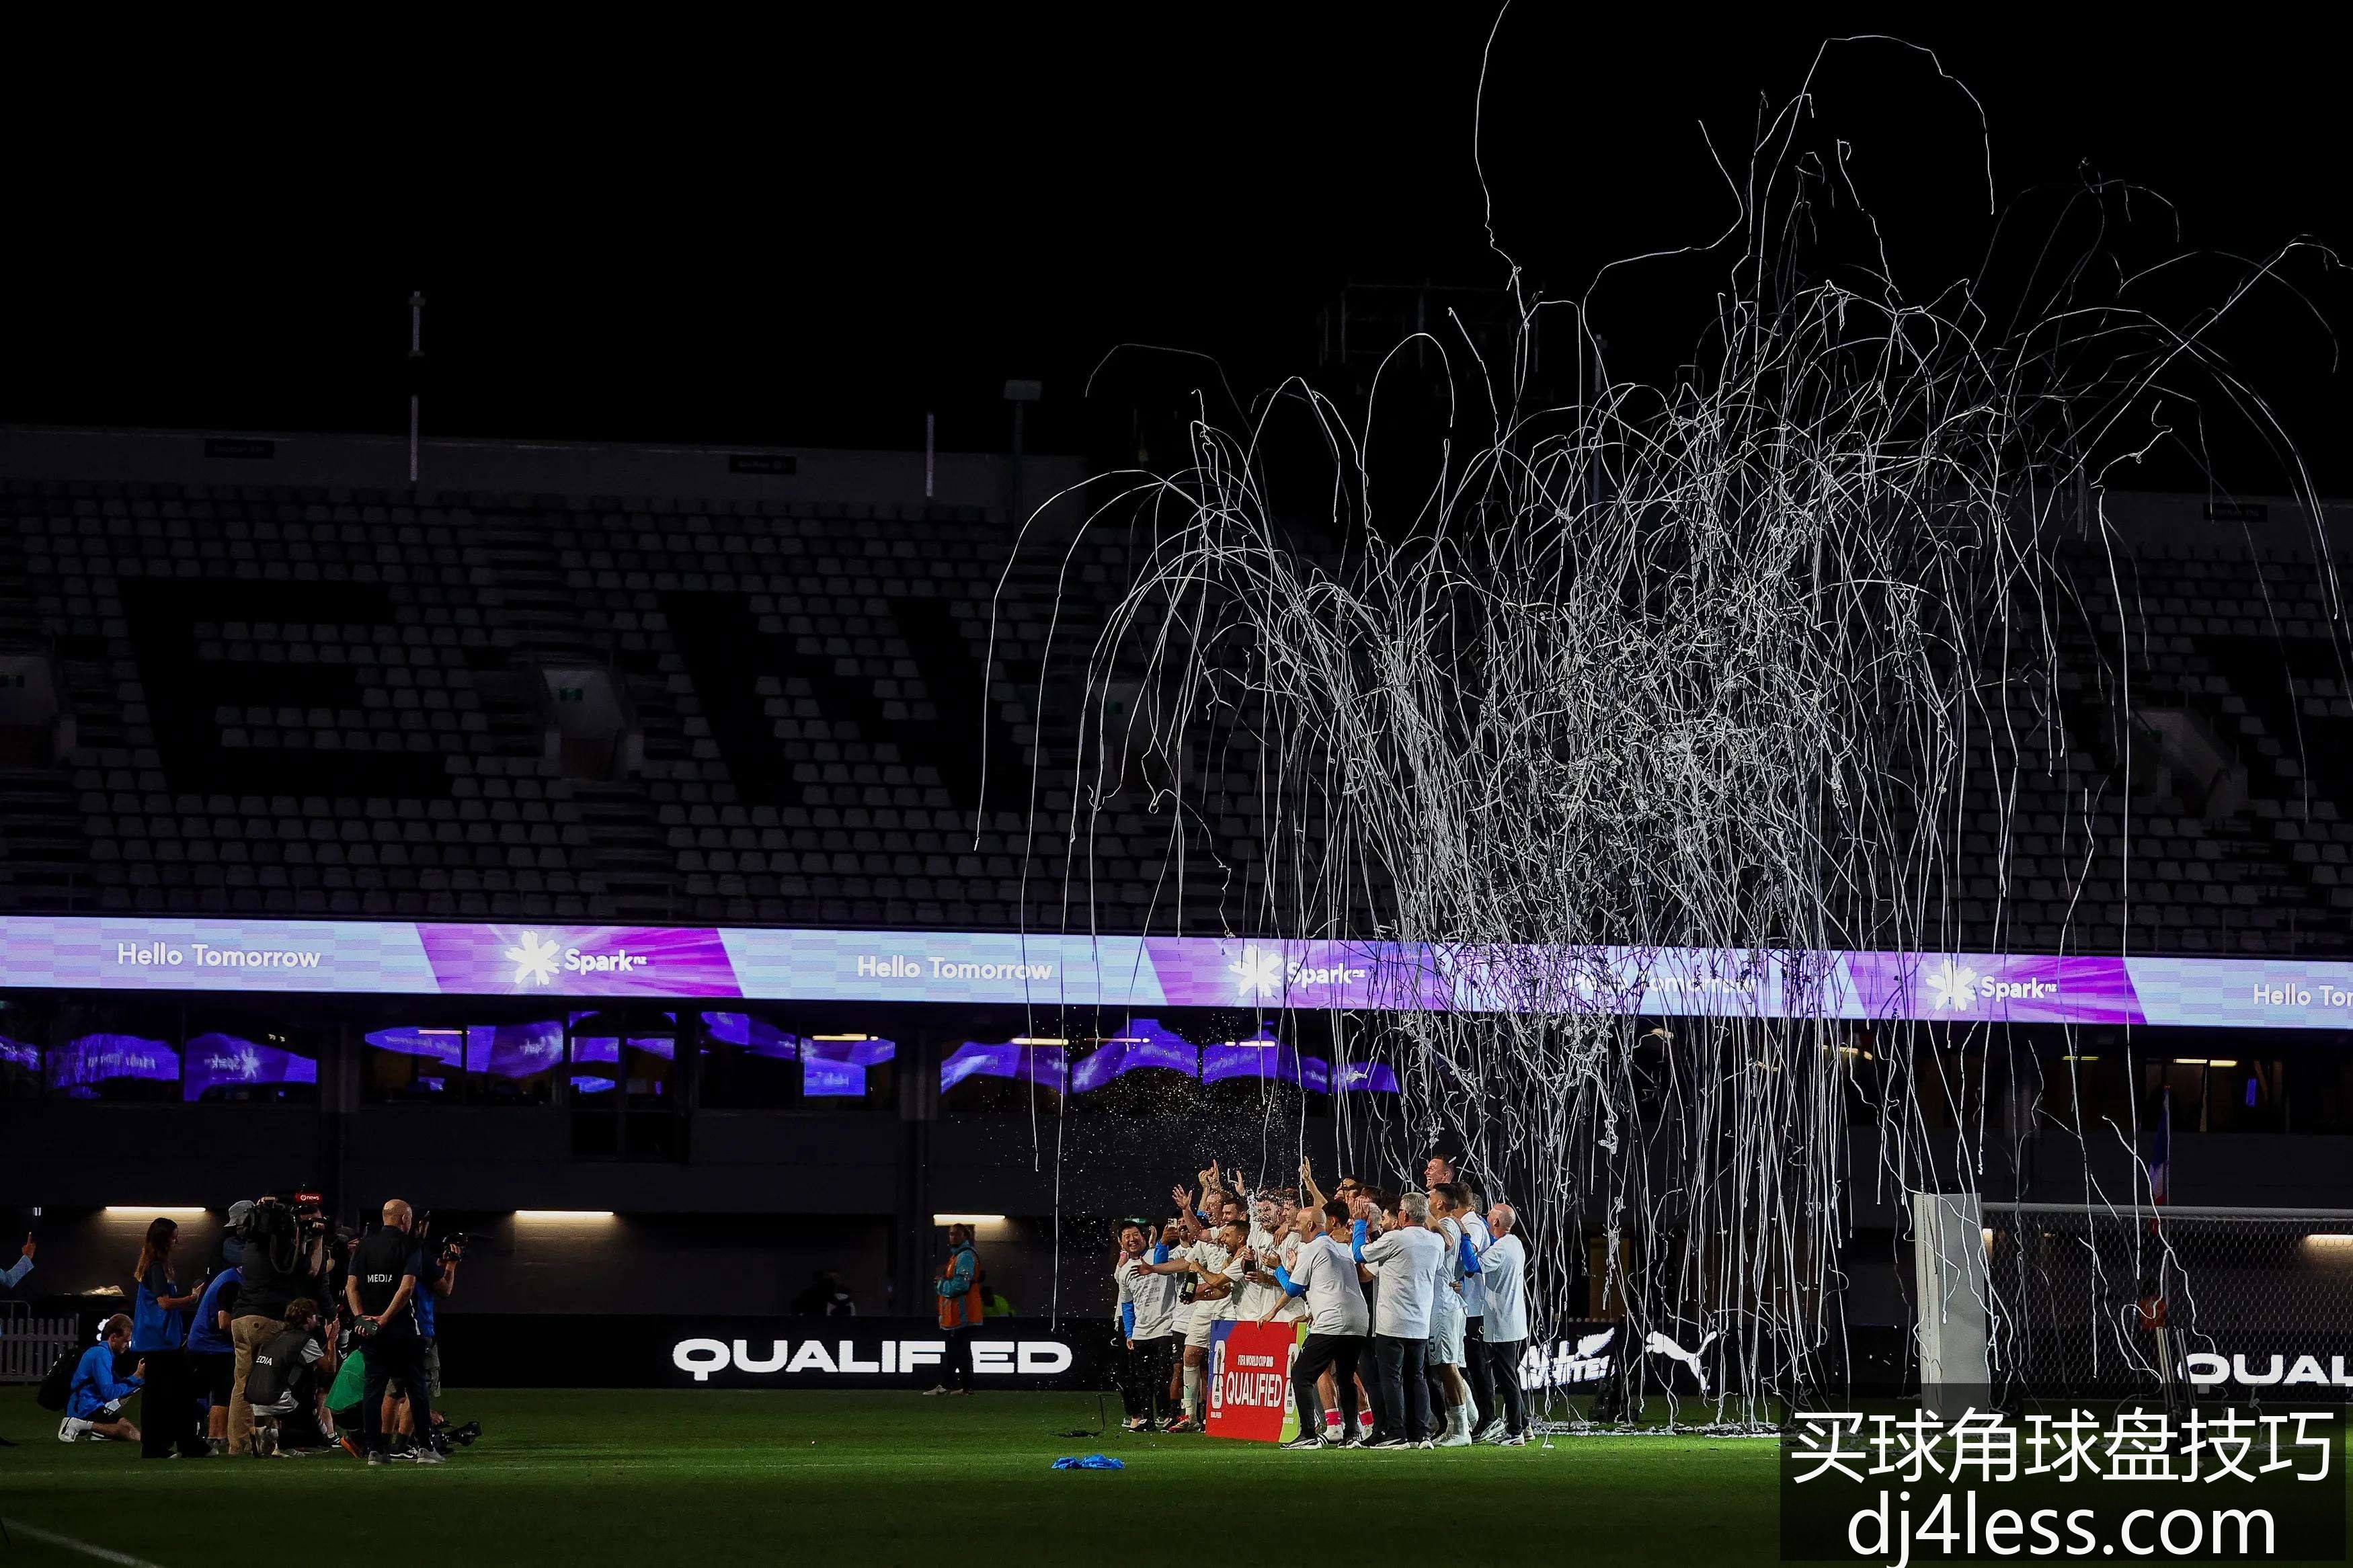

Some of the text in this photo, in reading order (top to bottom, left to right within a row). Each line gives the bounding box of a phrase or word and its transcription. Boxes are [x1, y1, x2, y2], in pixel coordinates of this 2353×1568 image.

[117, 942, 321, 969] Hello Tomorrow
[564, 948, 634, 975] Spark
[857, 955, 1052, 981] Hello Tomorrow
[1286, 960, 1352, 989] Spark
[1981, 976, 2046, 1003] Spark
[2254, 983, 2311, 1006] Hello
[367, 1274, 393, 1283] MEDIA
[256, 1356, 273, 1366] EDIA
[672, 1338, 1073, 1381] QUALIFED
[1226, 1371, 1283, 1407] QUALIFIED
